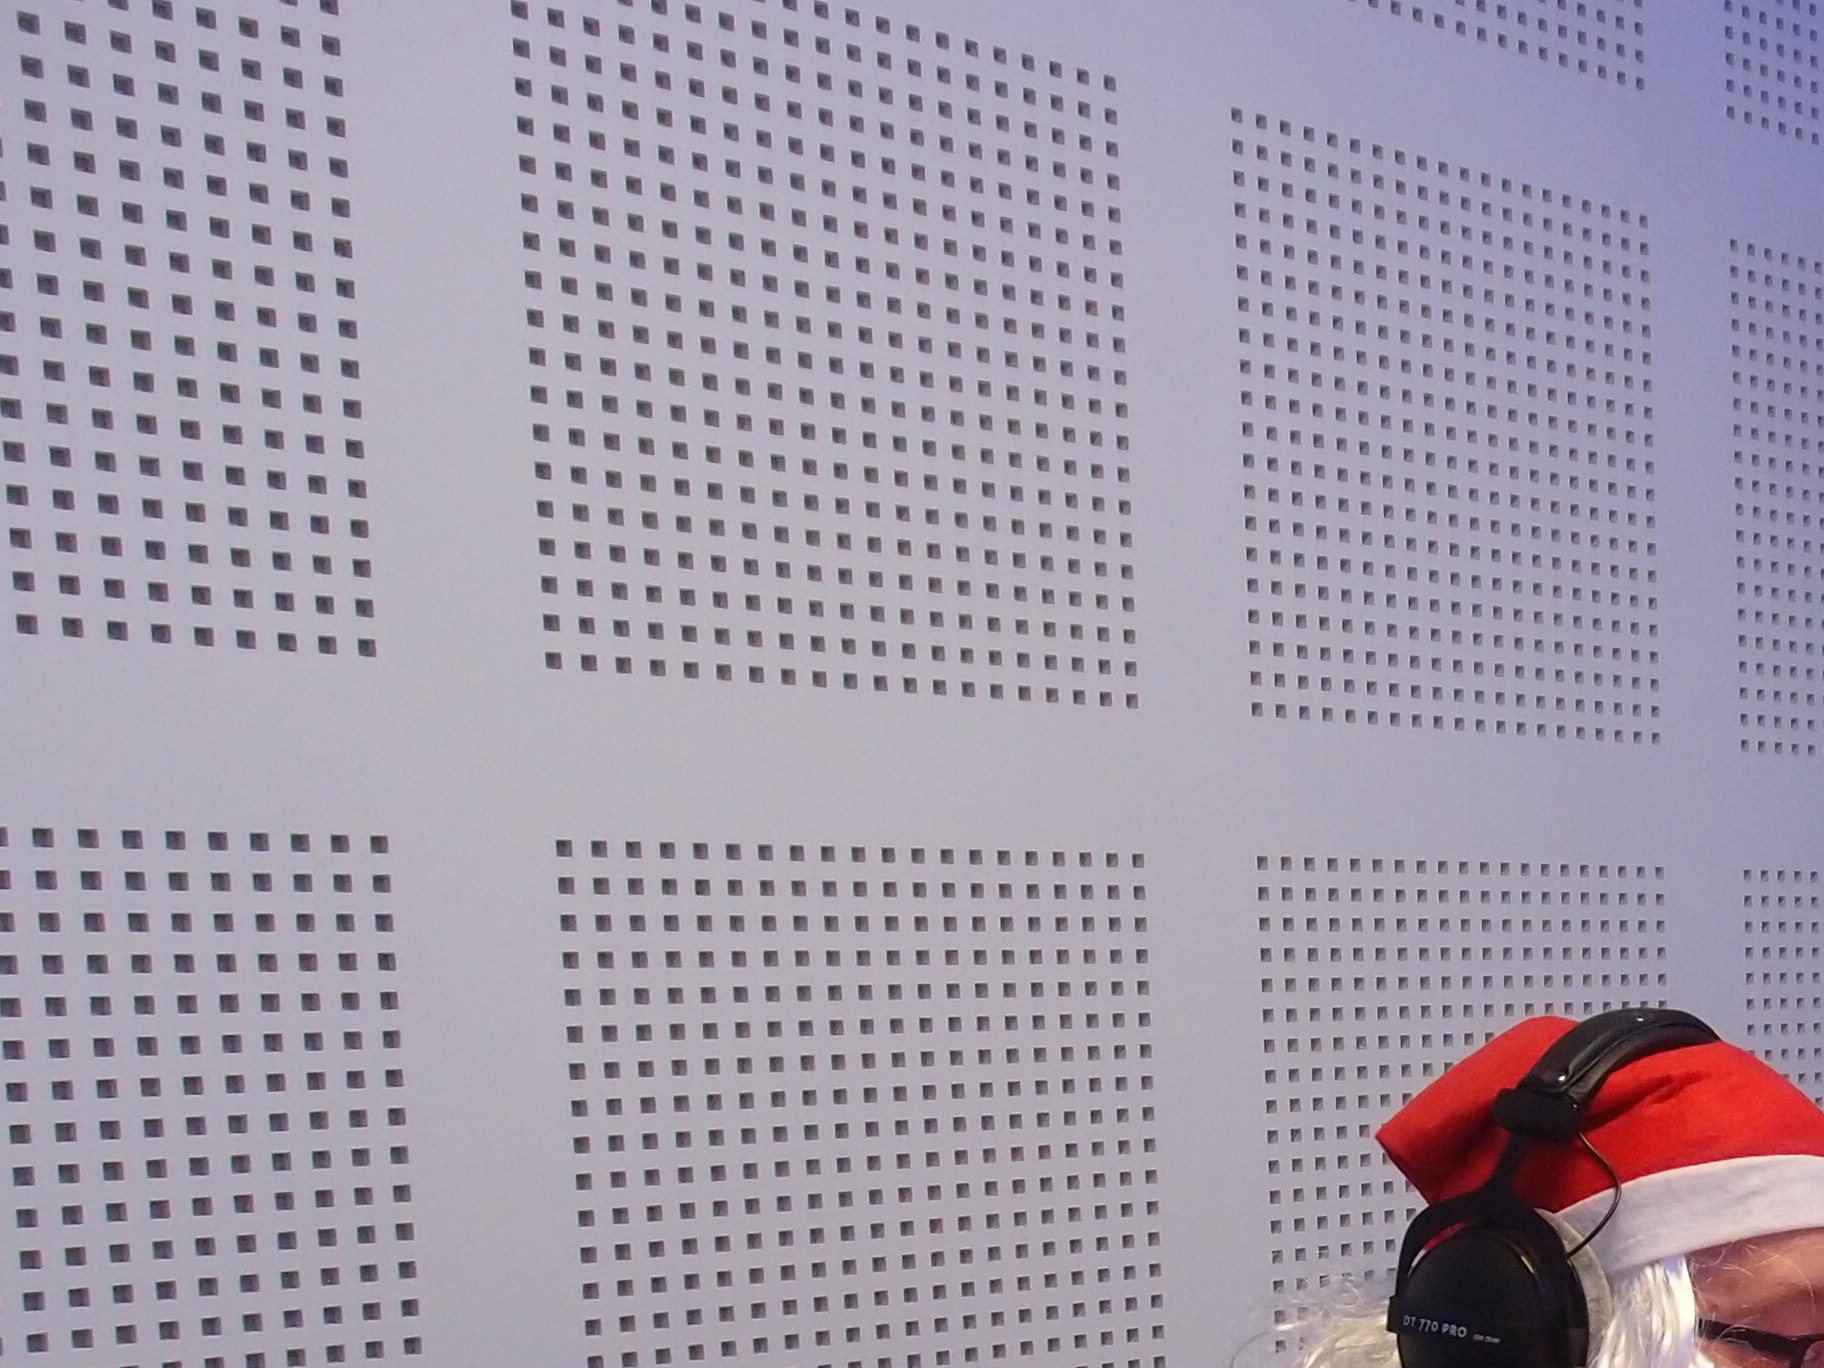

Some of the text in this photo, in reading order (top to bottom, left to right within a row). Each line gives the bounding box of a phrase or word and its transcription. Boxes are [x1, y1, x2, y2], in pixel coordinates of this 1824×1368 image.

[1402, 1314, 1467, 1338] DT 770 PRO
